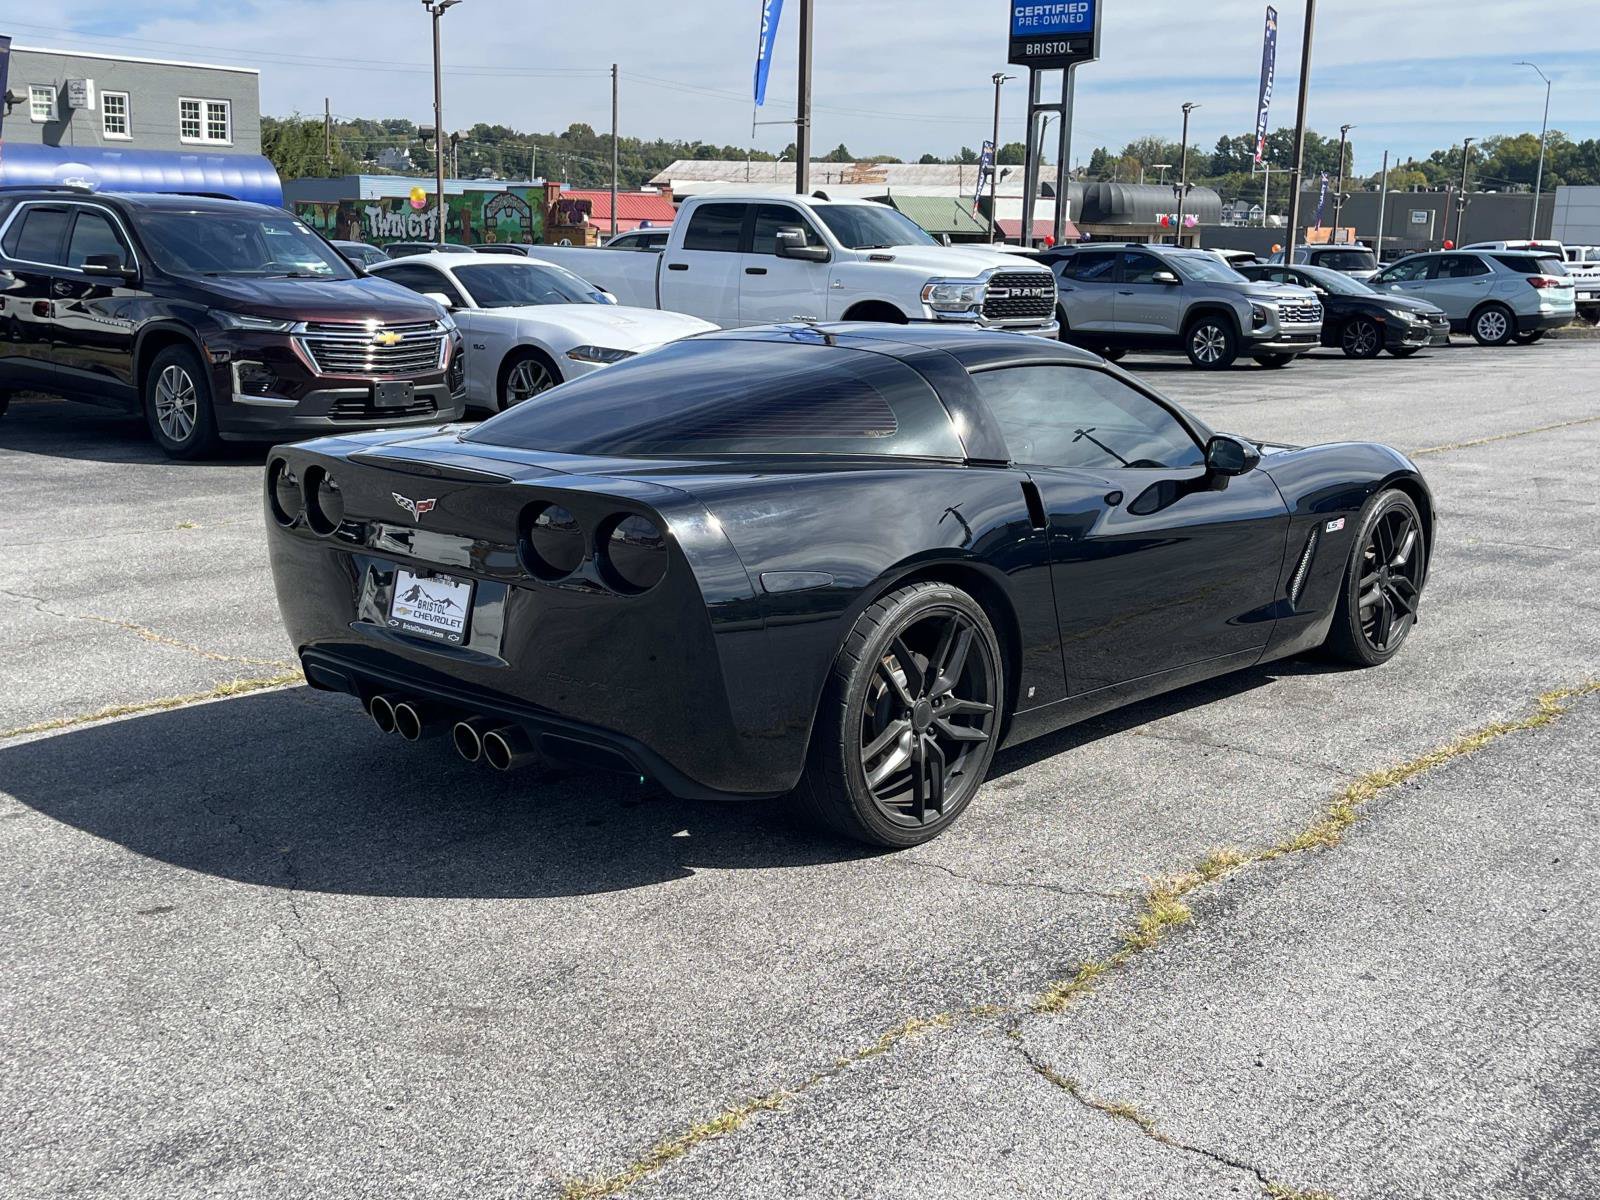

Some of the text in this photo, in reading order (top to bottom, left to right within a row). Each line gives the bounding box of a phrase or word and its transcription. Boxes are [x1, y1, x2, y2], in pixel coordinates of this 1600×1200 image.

[1014, 2, 1089, 17] CERTIFIED
[1018, 13, 1084, 26] PRE-OWNED
[1025, 42, 1073, 55] BRISTOL
[364, 205, 407, 239] TWIN
[1010, 287, 1042, 298] RAM
[417, 599, 446, 615] BRISTOL
[413, 610, 462, 628] CHEVROLET
